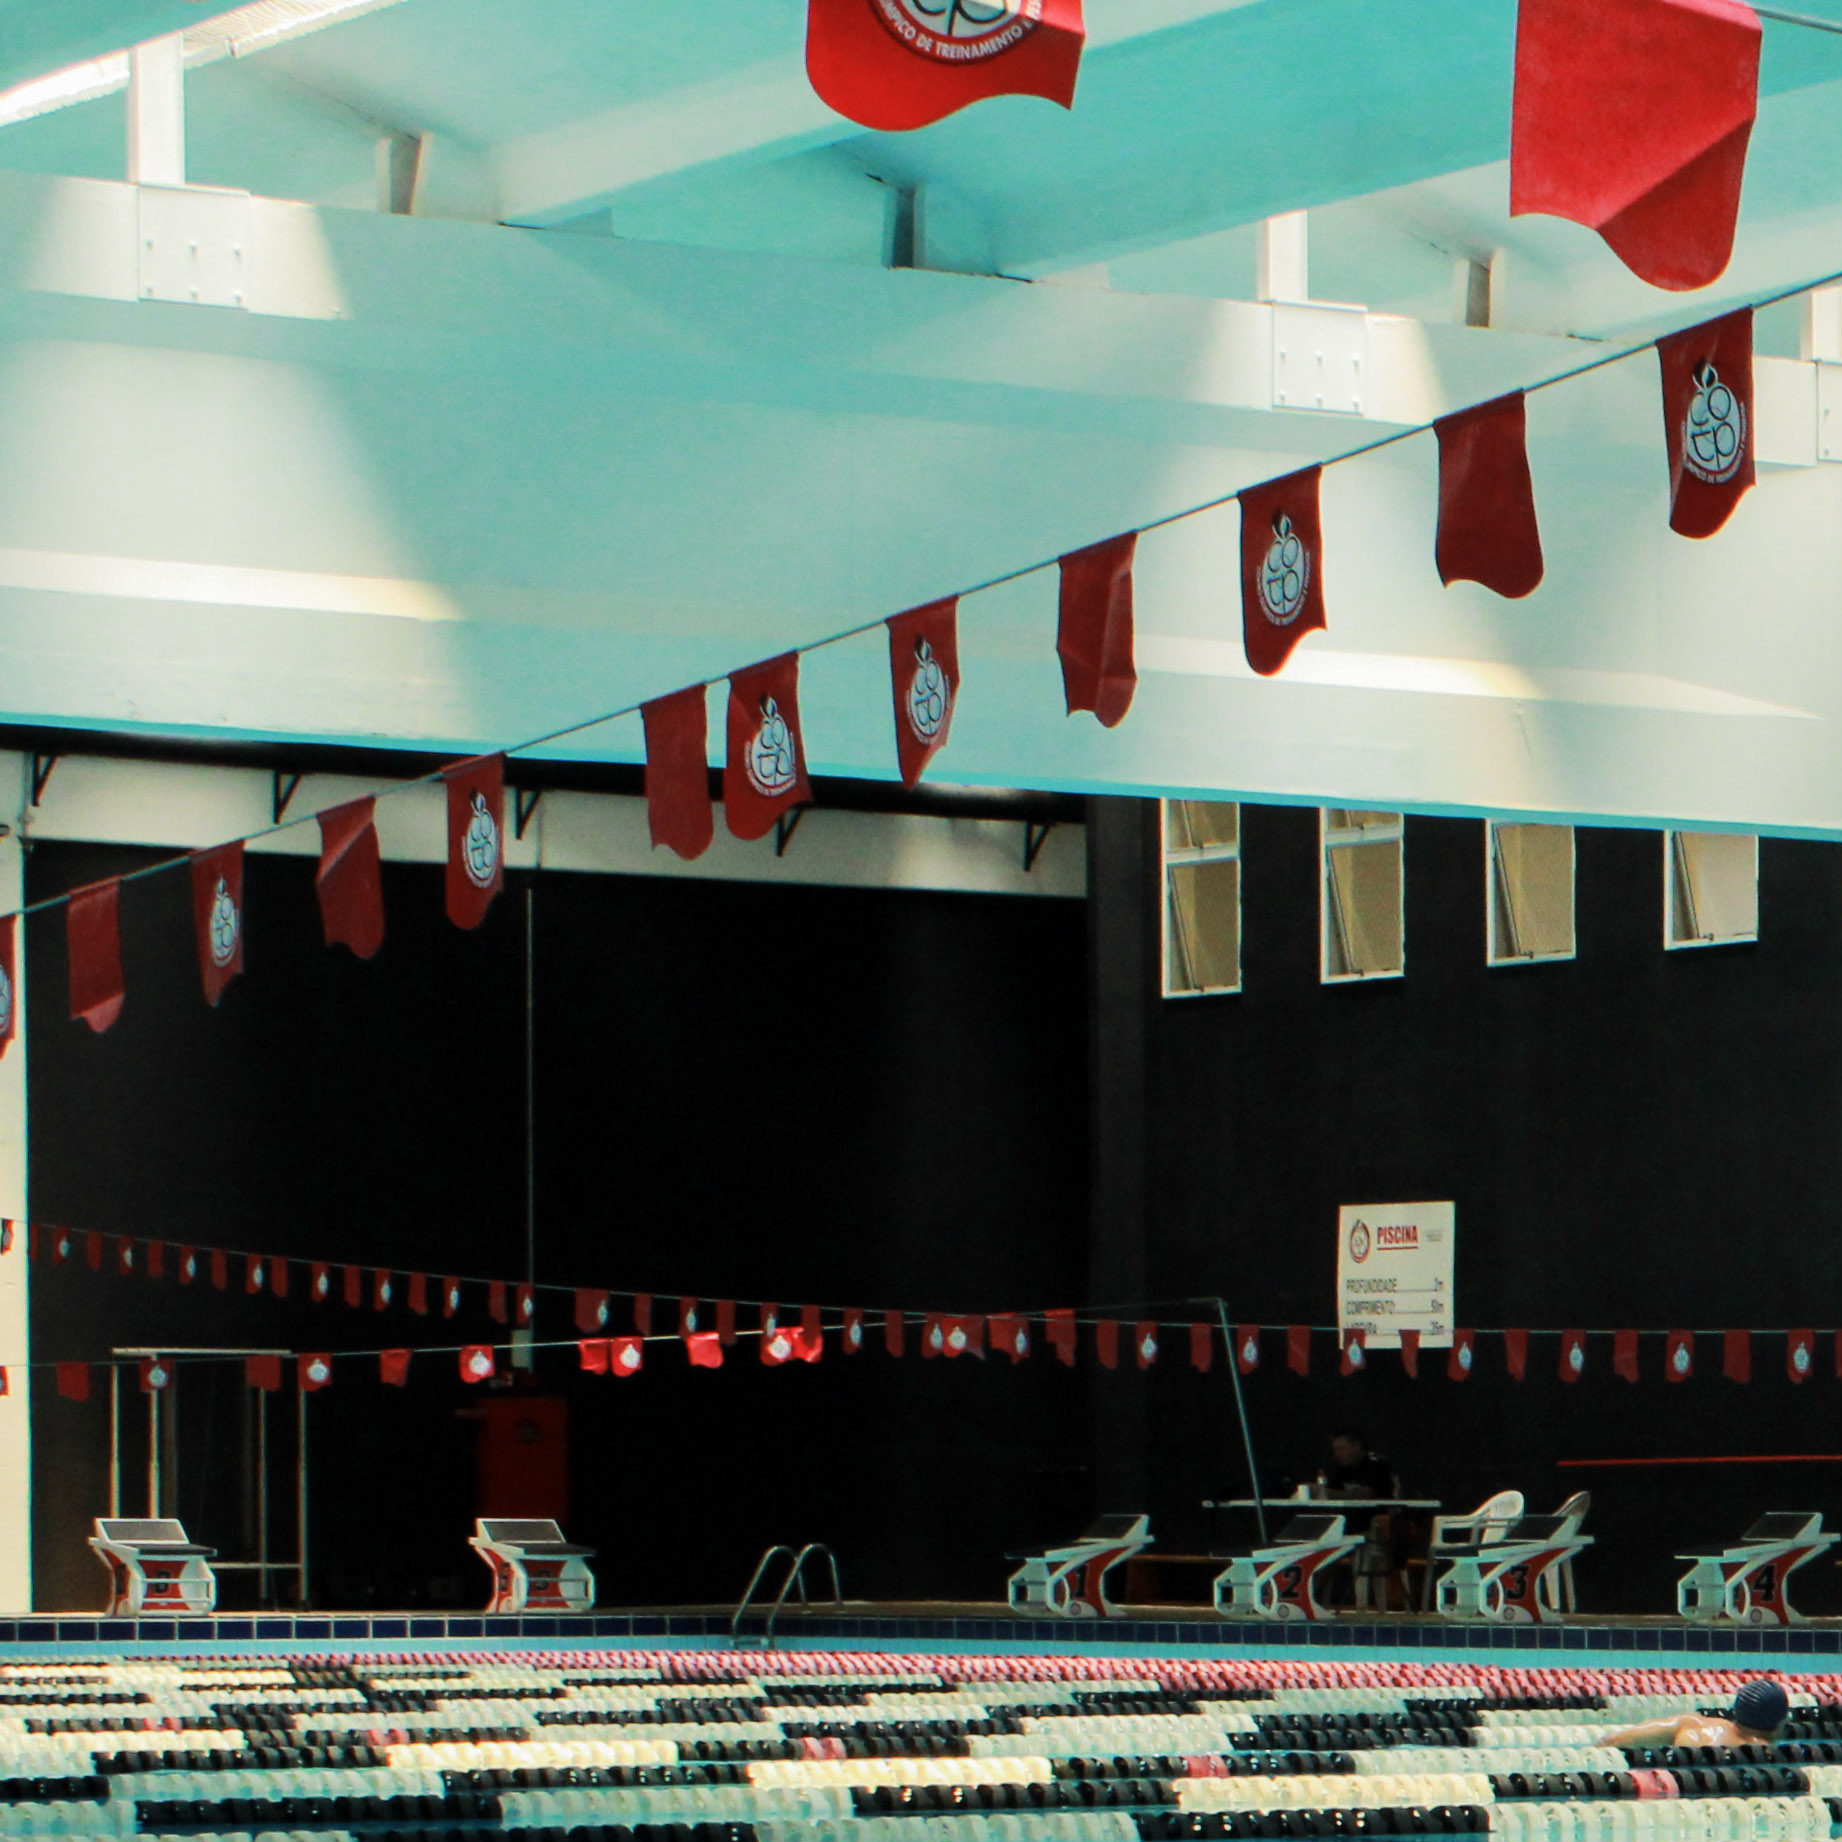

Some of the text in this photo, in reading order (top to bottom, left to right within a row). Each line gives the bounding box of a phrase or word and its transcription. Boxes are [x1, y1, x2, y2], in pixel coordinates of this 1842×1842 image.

[936, 25, 1022, 59] TREINAMENTO
[1378, 1225, 1419, 1245] PISCINA
[1074, 1563, 1087, 1598] 1
[1280, 1563, 1303, 1599] 2
[1504, 1564, 1529, 1599] 3
[1753, 1563, 1777, 1602] 4
